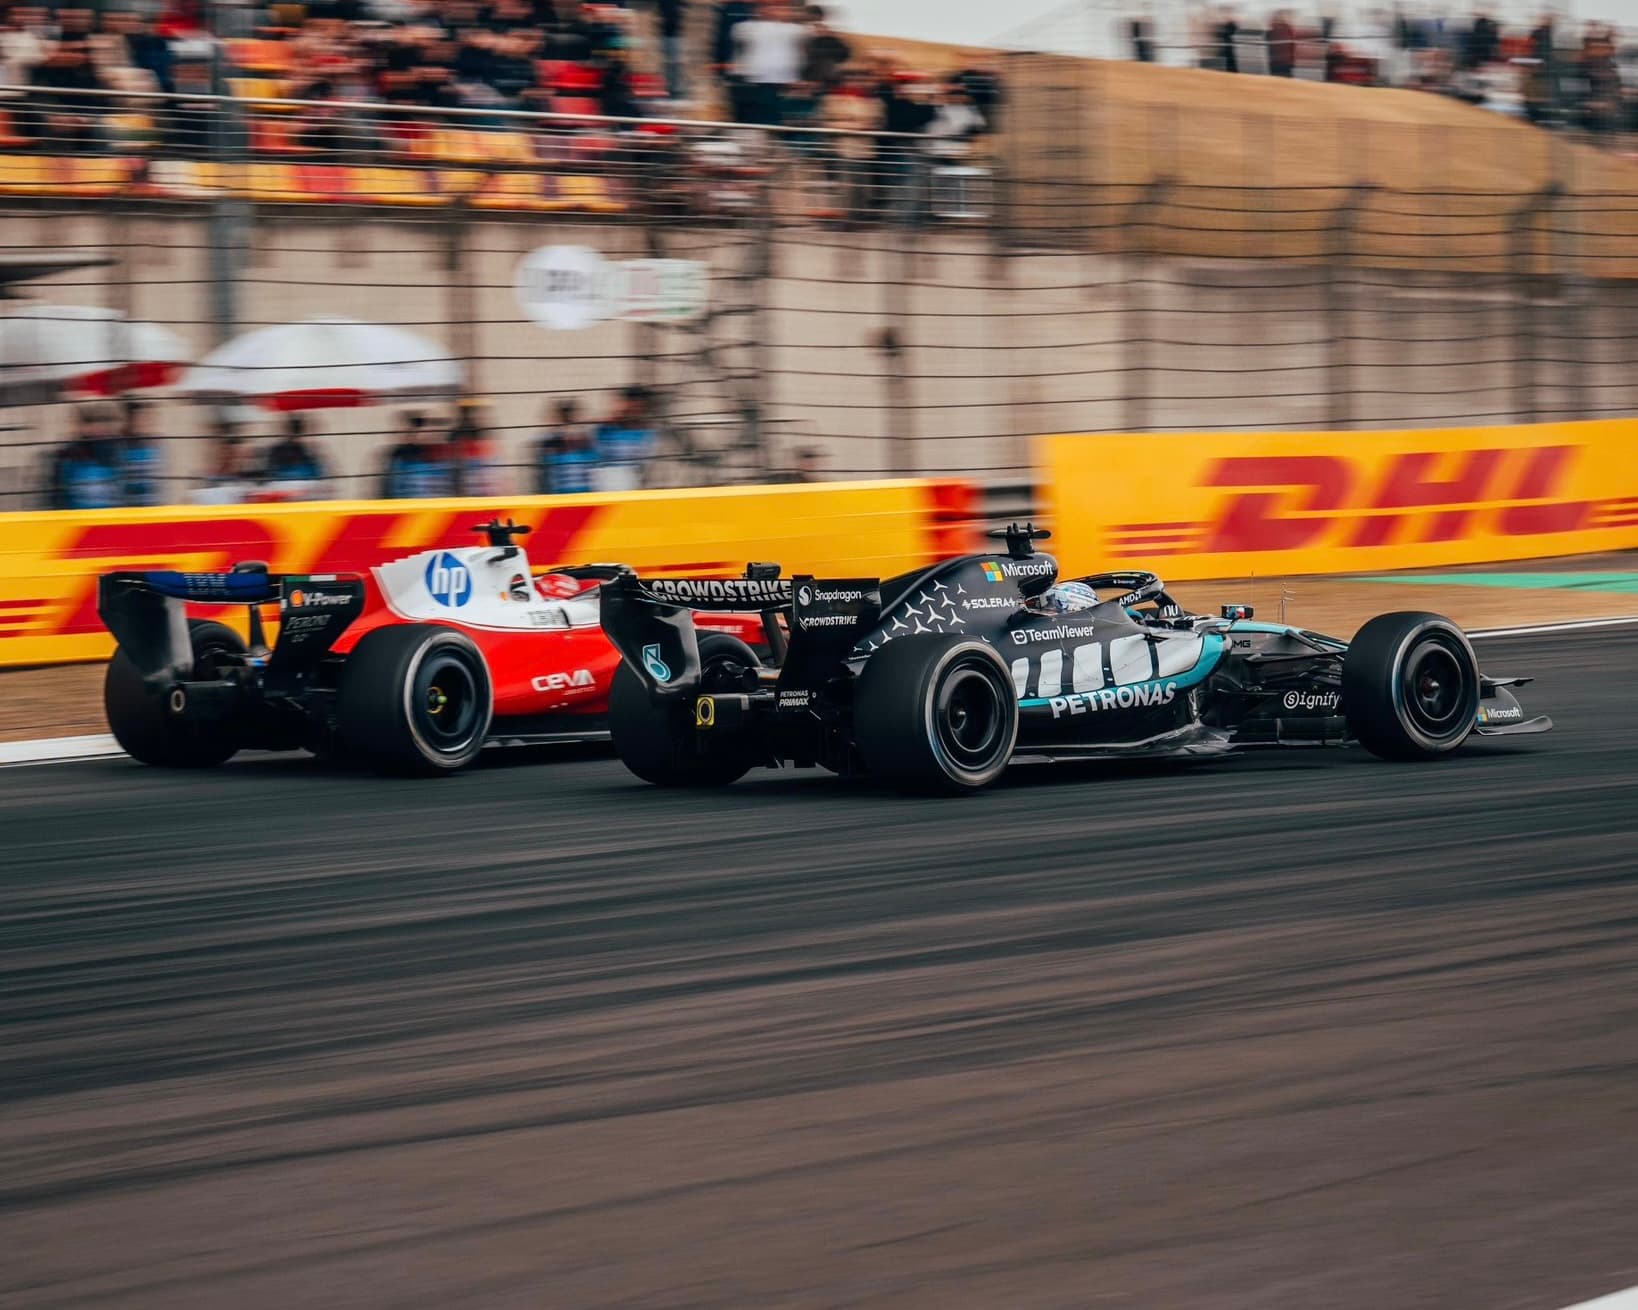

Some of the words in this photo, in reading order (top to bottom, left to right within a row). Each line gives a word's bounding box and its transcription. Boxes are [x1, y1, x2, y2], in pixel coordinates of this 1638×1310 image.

[1200, 444, 1593, 553] DHL
[1000, 560, 1054, 577] Microsoft
[431, 553, 468, 608] hp
[651, 579, 793, 601] CROWDSTRIKE
[814, 589, 862, 602] Snapdragon
[303, 592, 352, 606] V-Power
[971, 597, 1010, 608] SOLERA
[804, 615, 858, 627] CROWDSTRIKE
[1026, 625, 1095, 642] TeamViewer
[1231, 640, 1251, 648] MG
[531, 669, 597, 692] CEVA
[780, 690, 809, 698] PETRONAS
[1049, 682, 1177, 719] PETRONAS
[1283, 690, 1341, 710] Signify
[779, 697, 810, 707] PRIMAX
[1486, 707, 1521, 719] Microsoft
